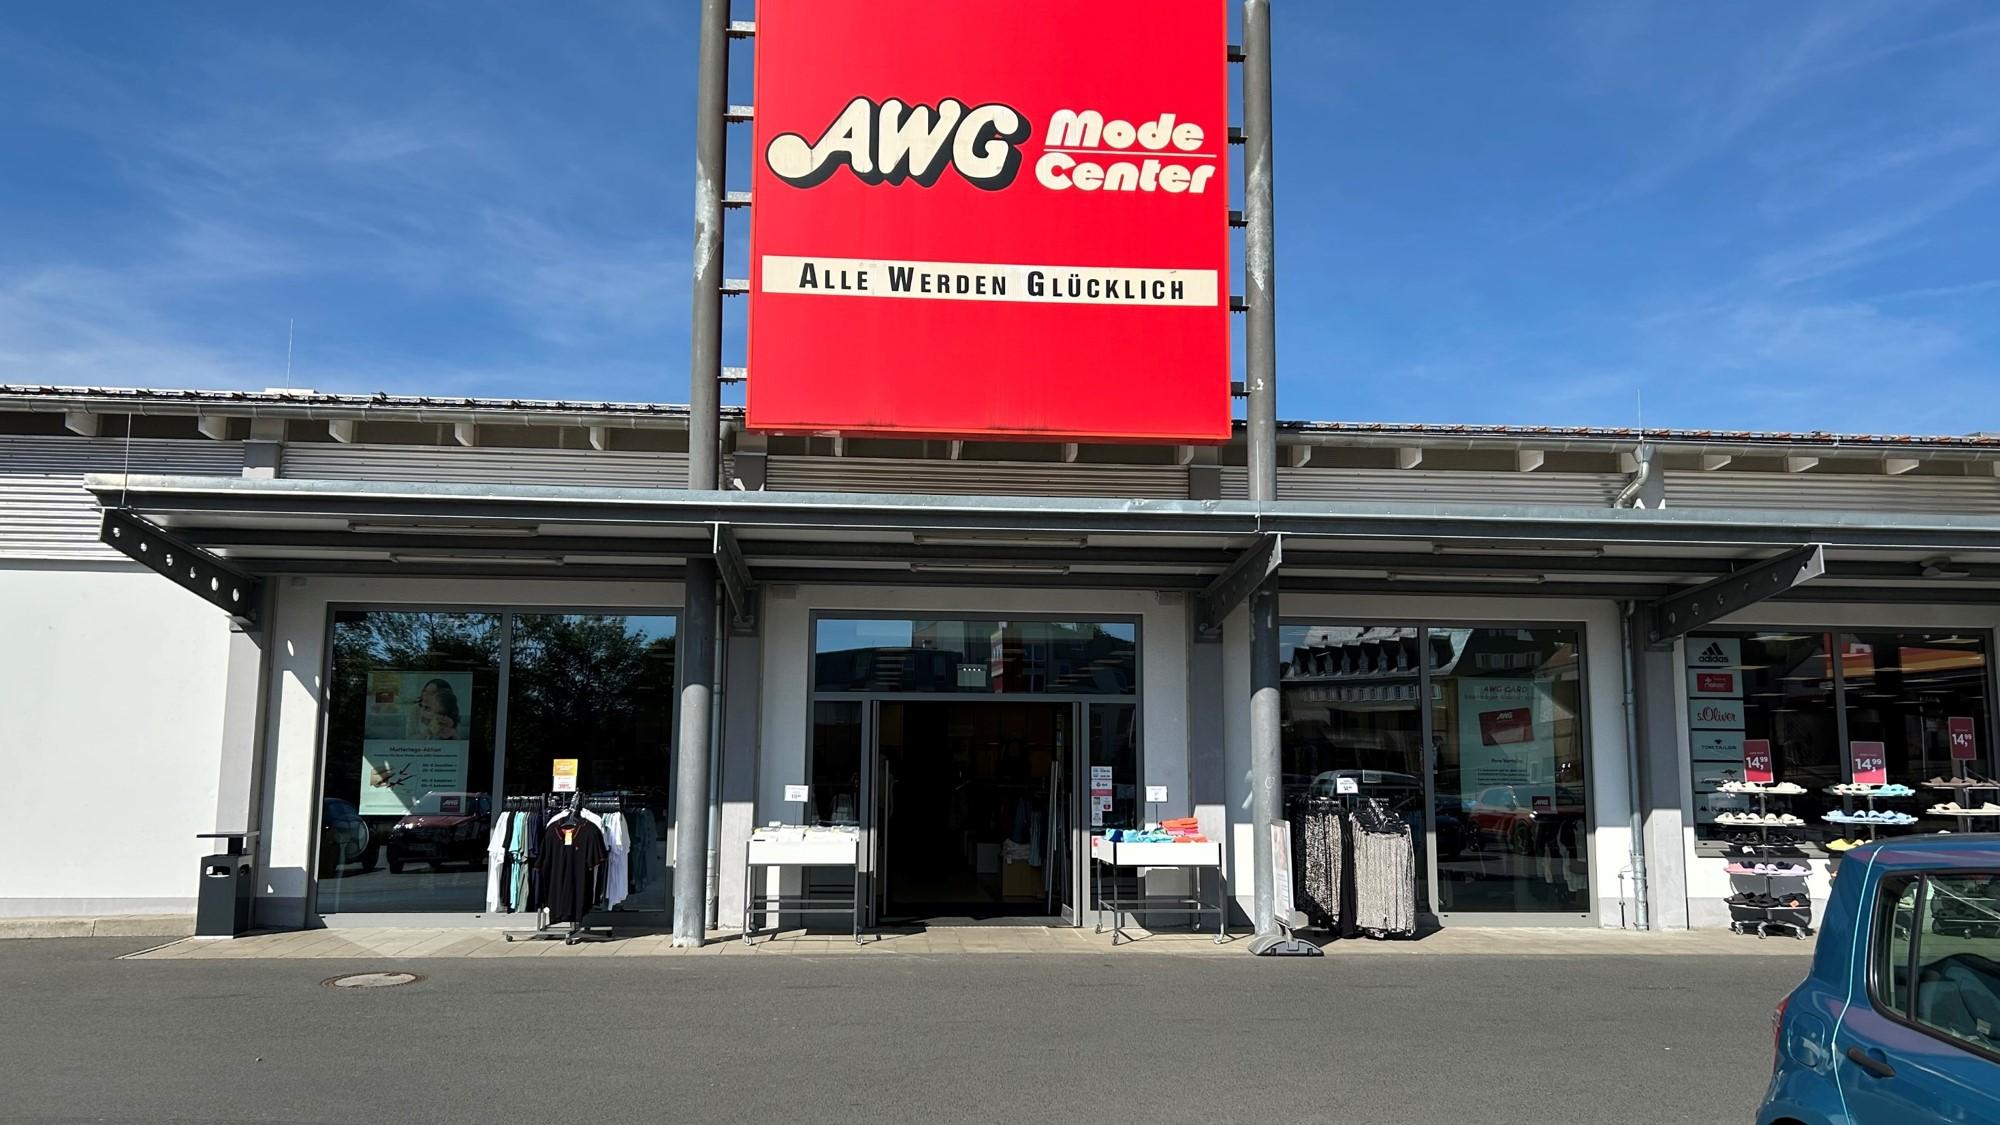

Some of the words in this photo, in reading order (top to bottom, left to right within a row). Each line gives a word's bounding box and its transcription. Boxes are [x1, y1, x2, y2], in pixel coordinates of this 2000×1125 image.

[766, 96, 1030, 189] AWG
[1045, 109, 1205, 151] Mode
[1035, 152, 1216, 193] Center
[799, 262, 869, 291] ALLE
[888, 265, 1006, 296] WERDEN
[1027, 270, 1184, 300] GLÜCKLICH
[1698, 655, 1729, 664] adidas
[1697, 706, 1737, 722] s.Oliver
